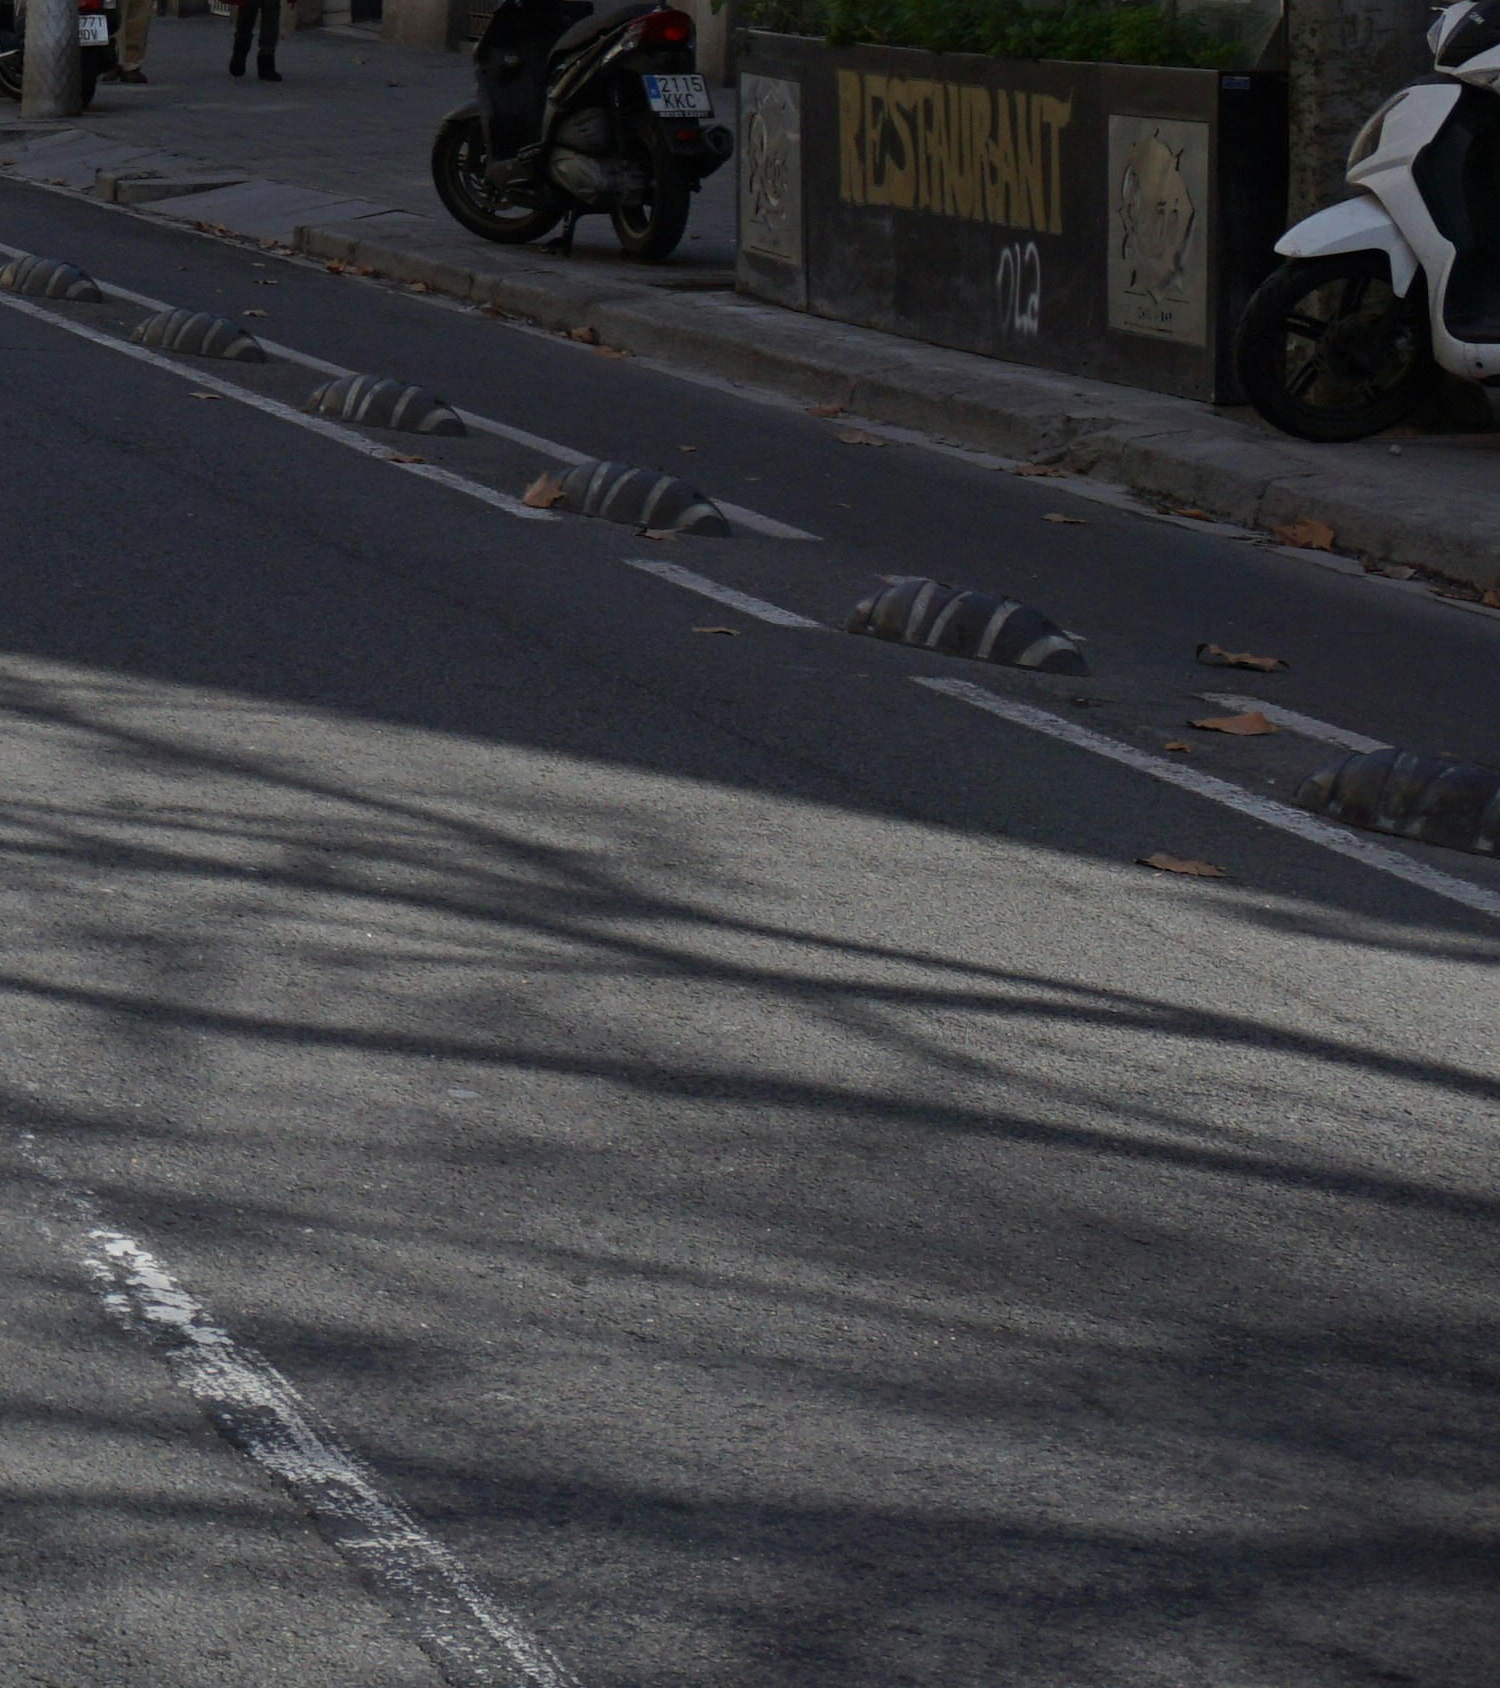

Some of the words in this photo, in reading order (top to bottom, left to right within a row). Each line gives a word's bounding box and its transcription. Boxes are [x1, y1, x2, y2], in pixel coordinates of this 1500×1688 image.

[79, 16, 103, 28] 771
[658, 76, 703, 93] 2115
[662, 93, 697, 109] KKC
[837, 67, 1074, 236] RESTAURANT
